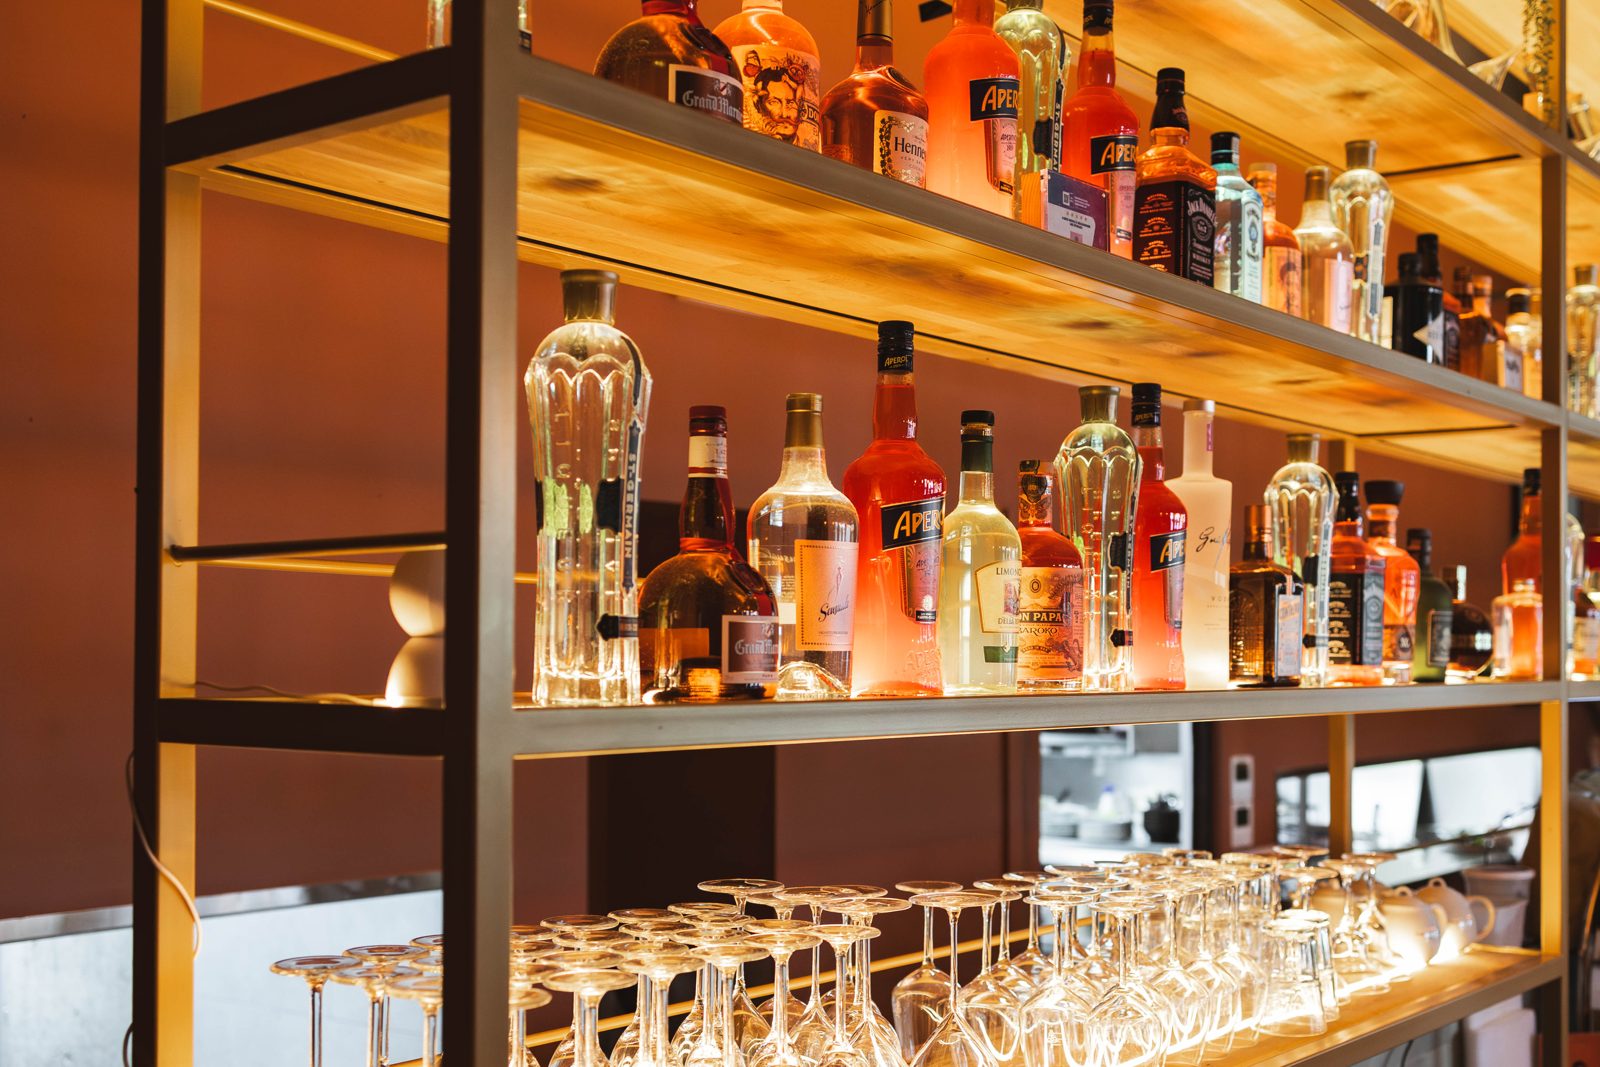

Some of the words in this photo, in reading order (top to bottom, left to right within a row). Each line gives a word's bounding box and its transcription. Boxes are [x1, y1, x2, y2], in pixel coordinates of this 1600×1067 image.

[682, 89, 717, 111] Grand
[884, 355, 908, 367] APEROL
[624, 453, 637, 558] ST-GERMAIN
[1033, 612, 1062, 622] PAPA
